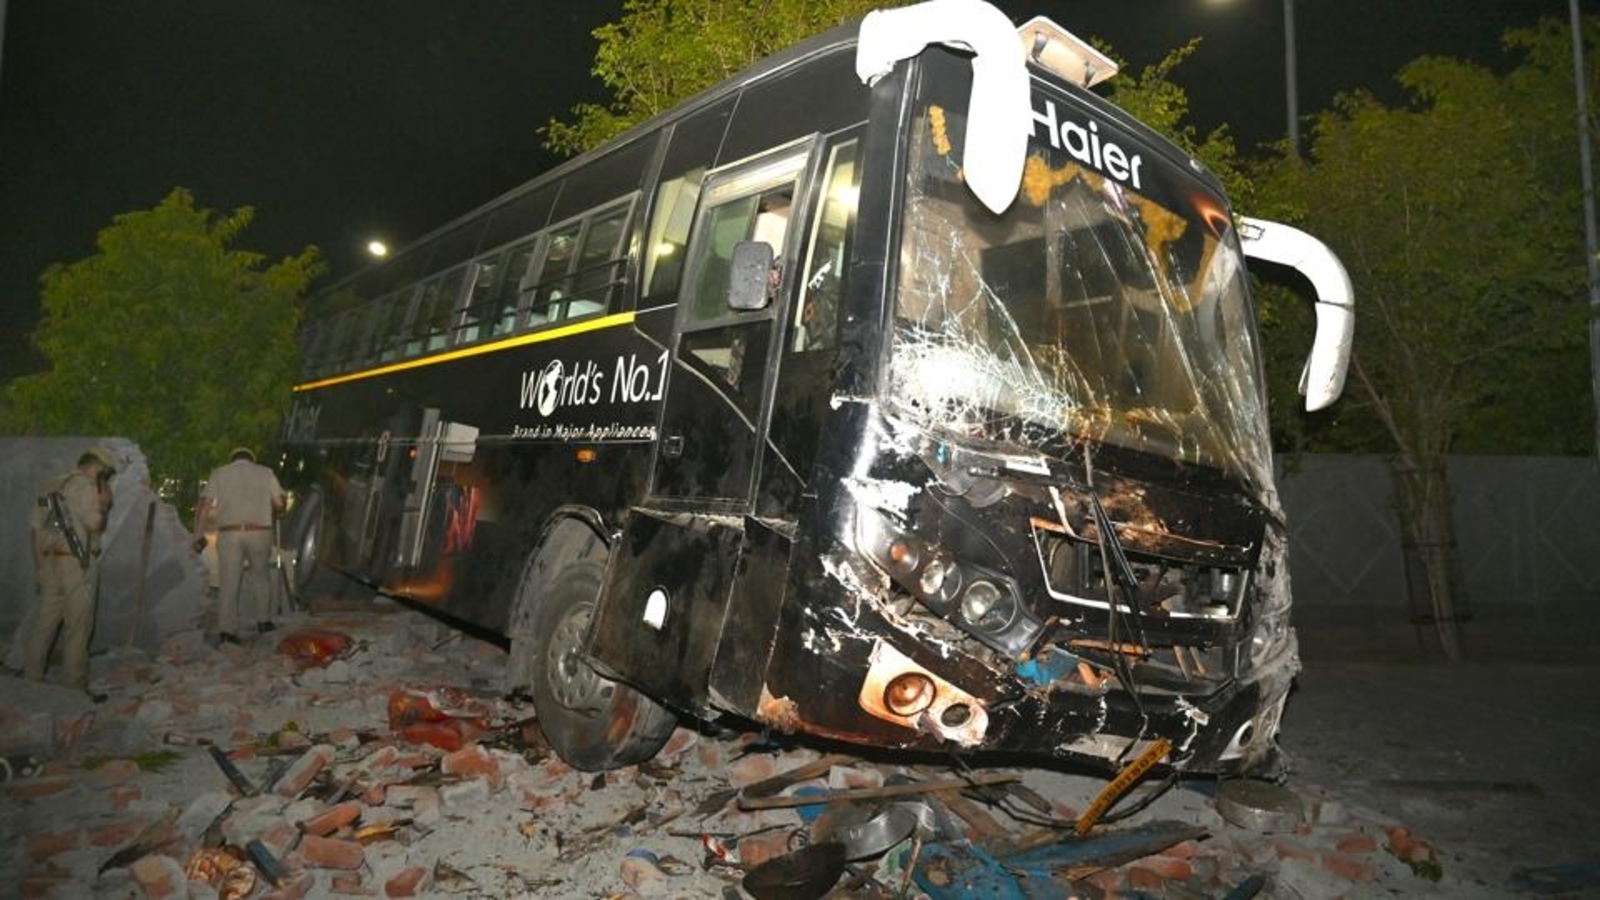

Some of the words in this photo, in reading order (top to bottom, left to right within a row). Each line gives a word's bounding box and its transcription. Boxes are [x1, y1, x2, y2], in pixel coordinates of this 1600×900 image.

[1028, 100, 1142, 190] Haier
[520, 359, 604, 416] World's
[610, 349, 669, 403] No.1
[512, 424, 541, 438] Brand
[541, 424, 553, 438] in
[553, 423, 584, 442] Major
[585, 422, 657, 441] Appliances
